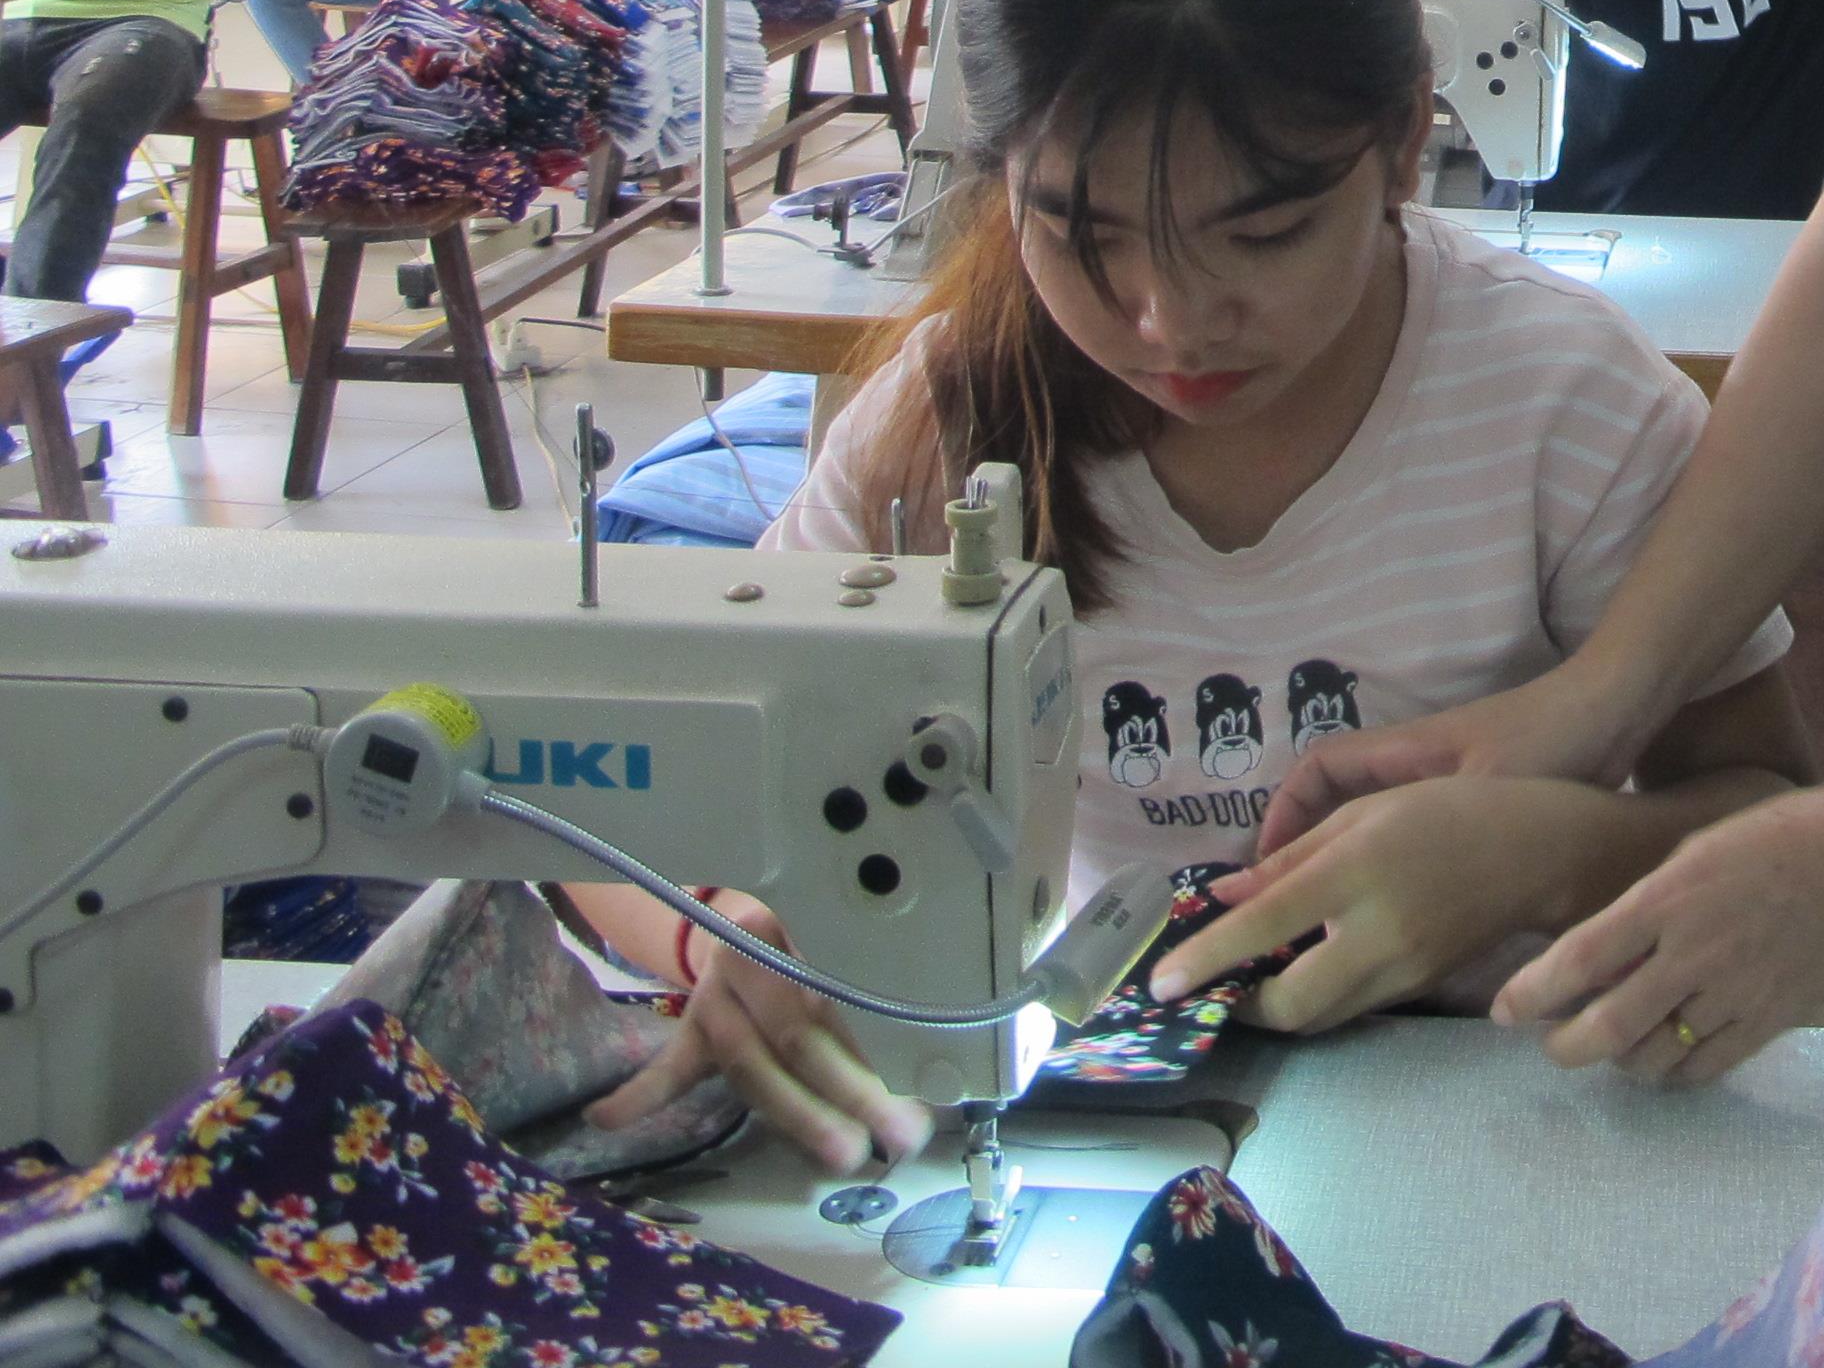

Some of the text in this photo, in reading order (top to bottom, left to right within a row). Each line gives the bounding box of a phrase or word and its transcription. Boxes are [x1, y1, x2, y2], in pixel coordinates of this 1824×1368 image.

[483, 736, 652, 790] UKI
[1139, 783, 1282, 829] BAD DOG
